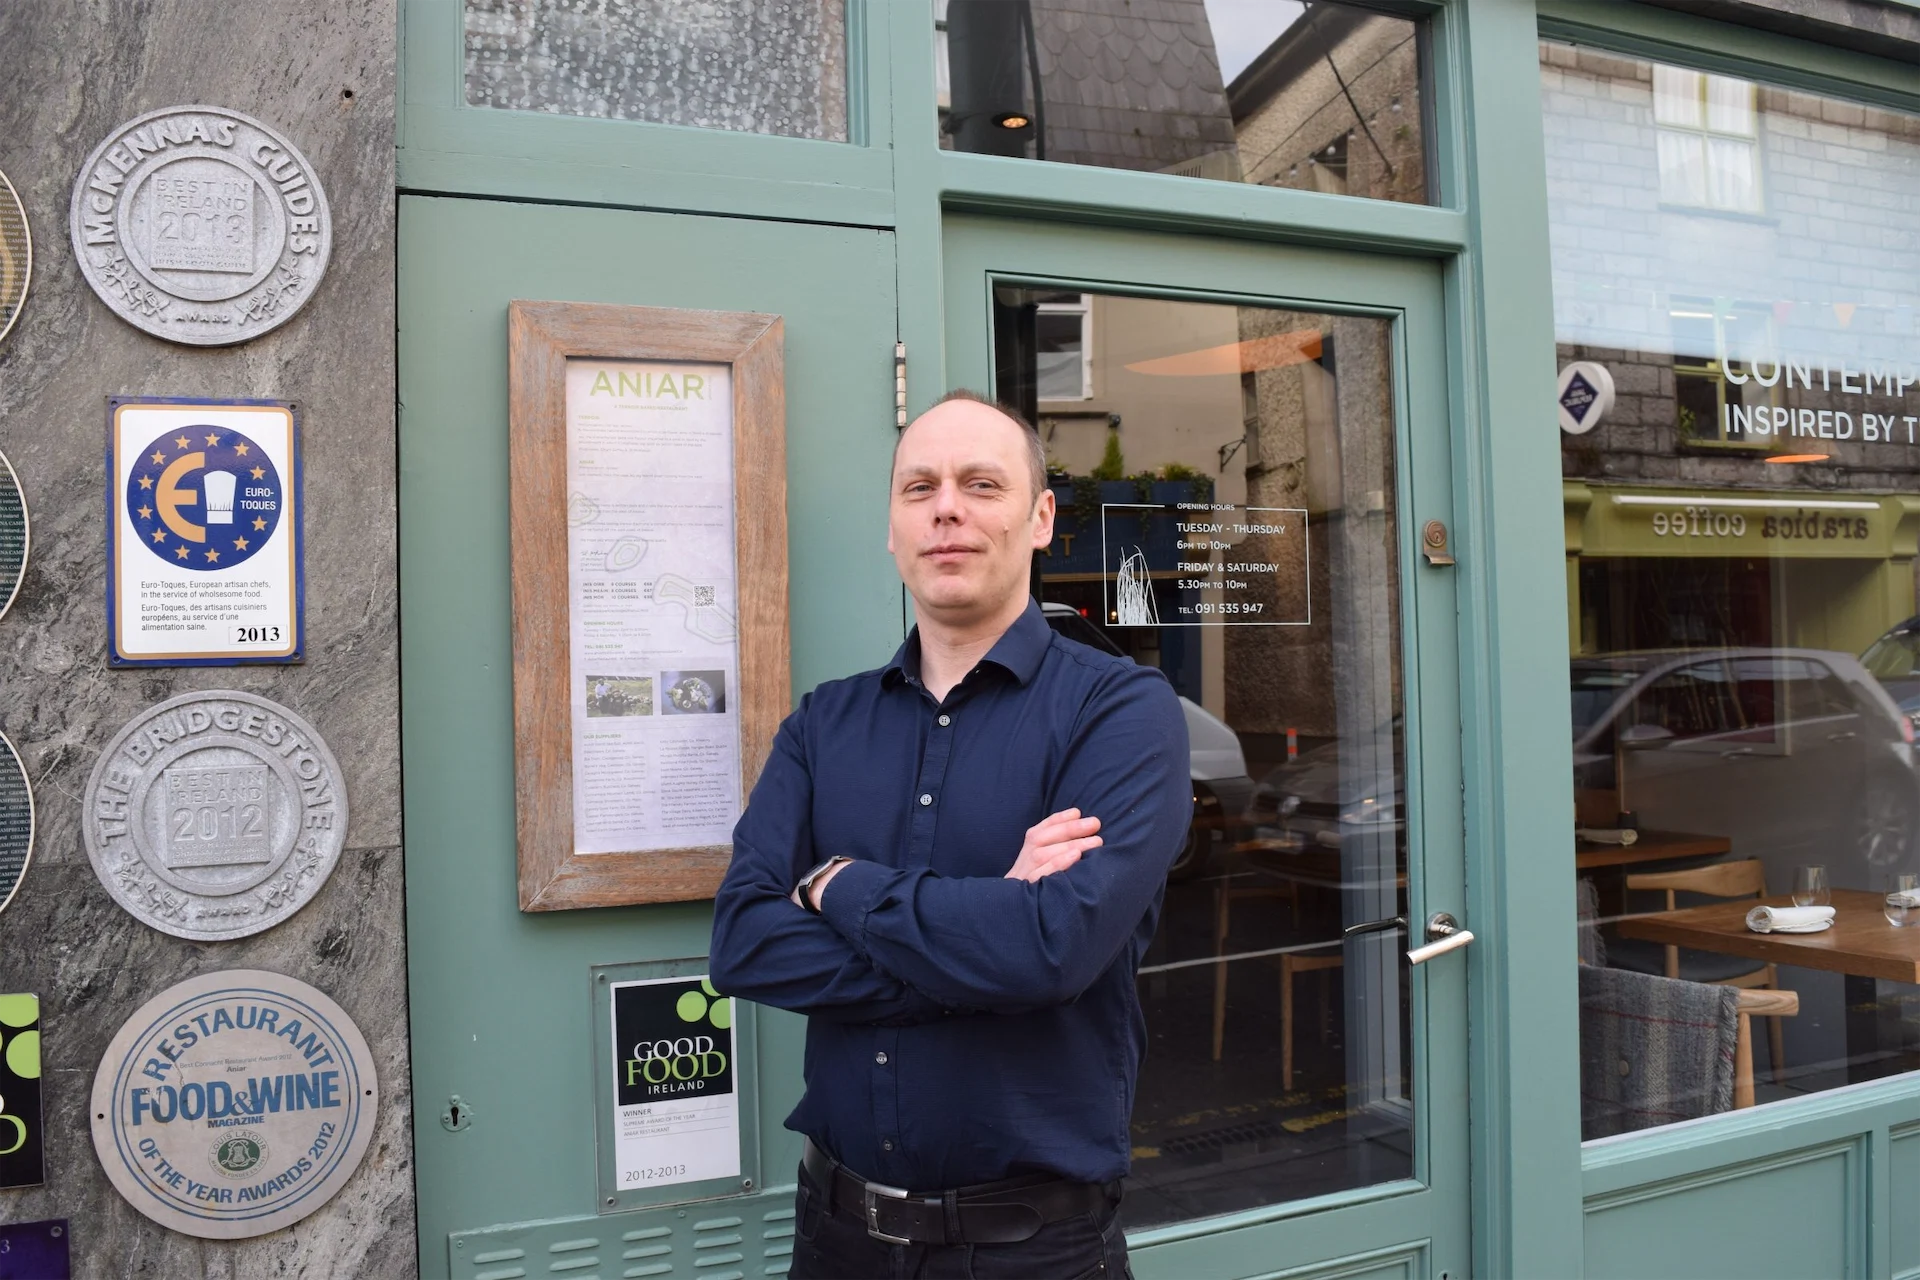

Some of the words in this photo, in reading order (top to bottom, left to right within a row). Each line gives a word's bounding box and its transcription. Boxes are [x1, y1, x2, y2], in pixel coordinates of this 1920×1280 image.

[156, 178, 216, 194] BEST
[224, 182, 248, 194] IN
[156, 194, 248, 212] IRELAND
[249, 139, 320, 257] GUIDES
[158, 211, 246, 244] 2013
[176, 313, 231, 325] AWARD
[589, 370, 705, 400] ANIAR
[1724, 403, 1853, 440] INSPIRED
[1861, 413, 1895, 443] BY
[1903, 416, 1920, 444] T
[245, 487, 275, 498] EURO-
[240, 500, 276, 511] TOQUES
[1176, 503, 1209, 511] OPENING
[1210, 503, 1236, 511] HOURS
[1176, 523, 1223, 533] TUESDAY
[1233, 524, 1286, 534] THURSDAY
[1197, 542, 1207, 550] TO
[1177, 562, 1214, 572] FRIDAY
[1217, 562, 1224, 572] &
[1227, 563, 1279, 573] SATURDAY
[141, 581, 188, 590] Euro-Toques,
[189, 580, 222, 589] European
[224, 580, 248, 588] artisan
[250, 580, 271, 589] chefs,
[1178, 579, 1210, 589] 5.30PM
[1213, 581, 1223, 589] TO
[244, 590, 262, 598] food.
[141, 604, 188, 612] Euro-Toques,
[204, 603, 232, 611] artisans
[233, 603, 267, 611] cuisiniers
[1195, 603, 1215, 614] 091
[1218, 603, 1239, 614] 535
[1242, 603, 1263, 614] 947
[141, 613, 180, 622] européens,
[192, 613, 217, 621] service
[141, 623, 184, 631] alimentation
[186, 623, 207, 631] saine.
[237, 626, 280, 642] 2013
[99, 770, 135, 847] THE
[123, 706, 334, 830] BRIDGESTONE
[170, 772, 230, 788] BEST
[239, 770, 262, 786] IN
[170, 787, 262, 805] IRELAND
[173, 804, 263, 842] 2012
[196, 904, 250, 919] AWARD
[142, 1005, 335, 1083] RESTAURANT
[633, 1035, 714, 1062] GOOD
[224, 1057, 257, 1065] Restaurant
[258, 1055, 278, 1063] Award
[625, 1050, 727, 1086] FOOD
[647, 1080, 705, 1095] IRELAND
[622, 1108, 652, 1117] WINNER
[207, 1115, 265, 1129] MAGAZINE
[211, 1133, 233, 1155] LOUIS
[235, 1131, 266, 1150] LATOUR
[138, 1137, 161, 1162] OF
[153, 1151, 187, 1190] THE
[187, 1179, 233, 1204] YEAR
[237, 1156, 313, 1204] AWARDS
[308, 1120, 336, 1161] 2012
[625, 1164, 686, 1183] 2012-2013
